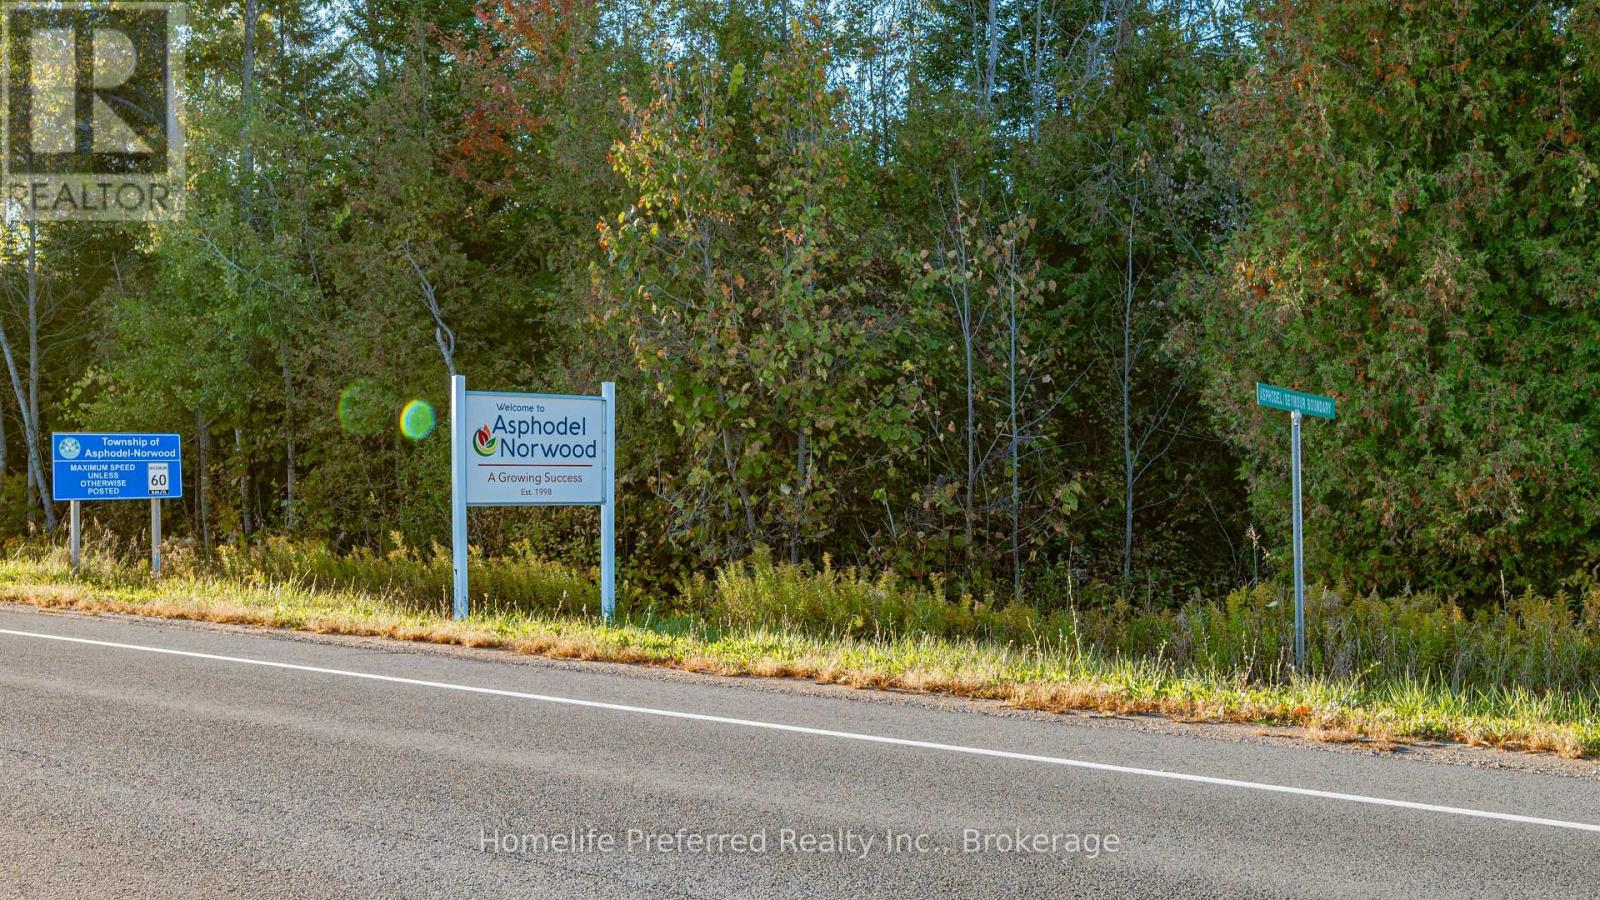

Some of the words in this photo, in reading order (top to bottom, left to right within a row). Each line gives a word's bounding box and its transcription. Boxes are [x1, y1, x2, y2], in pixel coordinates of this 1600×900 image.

[496, 403, 534, 412] Welcome
[537, 404, 545, 412] to
[1307, 398, 1332, 414] BOUNDARY
[492, 415, 586, 438] Asphodel
[102, 437, 148, 447] Township
[150, 437, 160, 446] of
[501, 438, 597, 458] Norwood
[85, 449, 176, 459] Asphodel-Norwood
[151, 474, 167, 486] 60
[488, 473, 495, 482] A
[498, 472, 542, 485] Growing
[544, 473, 583, 483] Success
[535, 488, 552, 496] 1998
